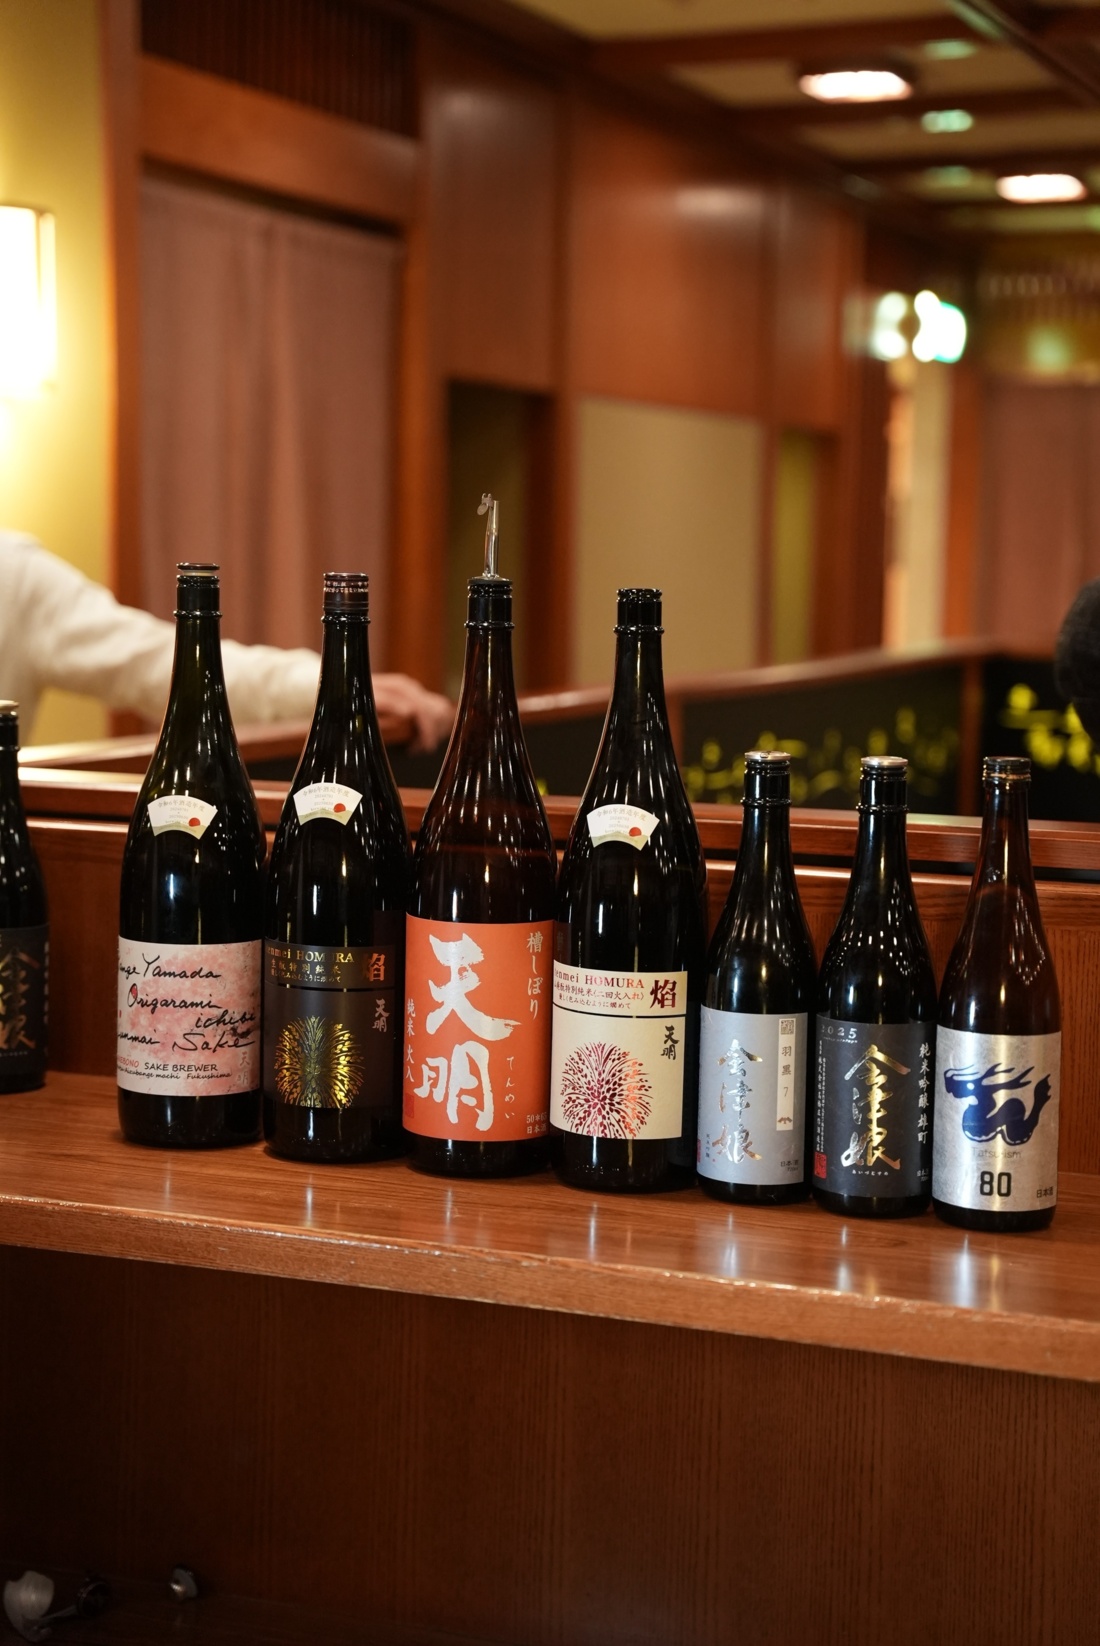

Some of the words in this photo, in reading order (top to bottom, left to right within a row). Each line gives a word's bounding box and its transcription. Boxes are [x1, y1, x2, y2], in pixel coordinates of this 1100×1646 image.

[142, 953, 221, 978] Yamada
[526, 931, 544, 1020] 槽しぼり
[584, 974, 645, 989] HOMURA
[127, 983, 222, 1014] Origarami
[372, 998, 390, 1032] 天明
[406, 998, 416, 1037] 純米
[172, 1030, 255, 1054] Sake
[413, 932, 523, 1132] 天明
[661, 1025, 679, 1060] 天明
[144, 1062, 169, 1072] SAKE
[172, 1064, 218, 1072] BREWER
[186, 1072, 233, 1080] Fukushima
[504, 1056, 516, 1119] てんめい
[979, 1171, 1012, 1197] 80
